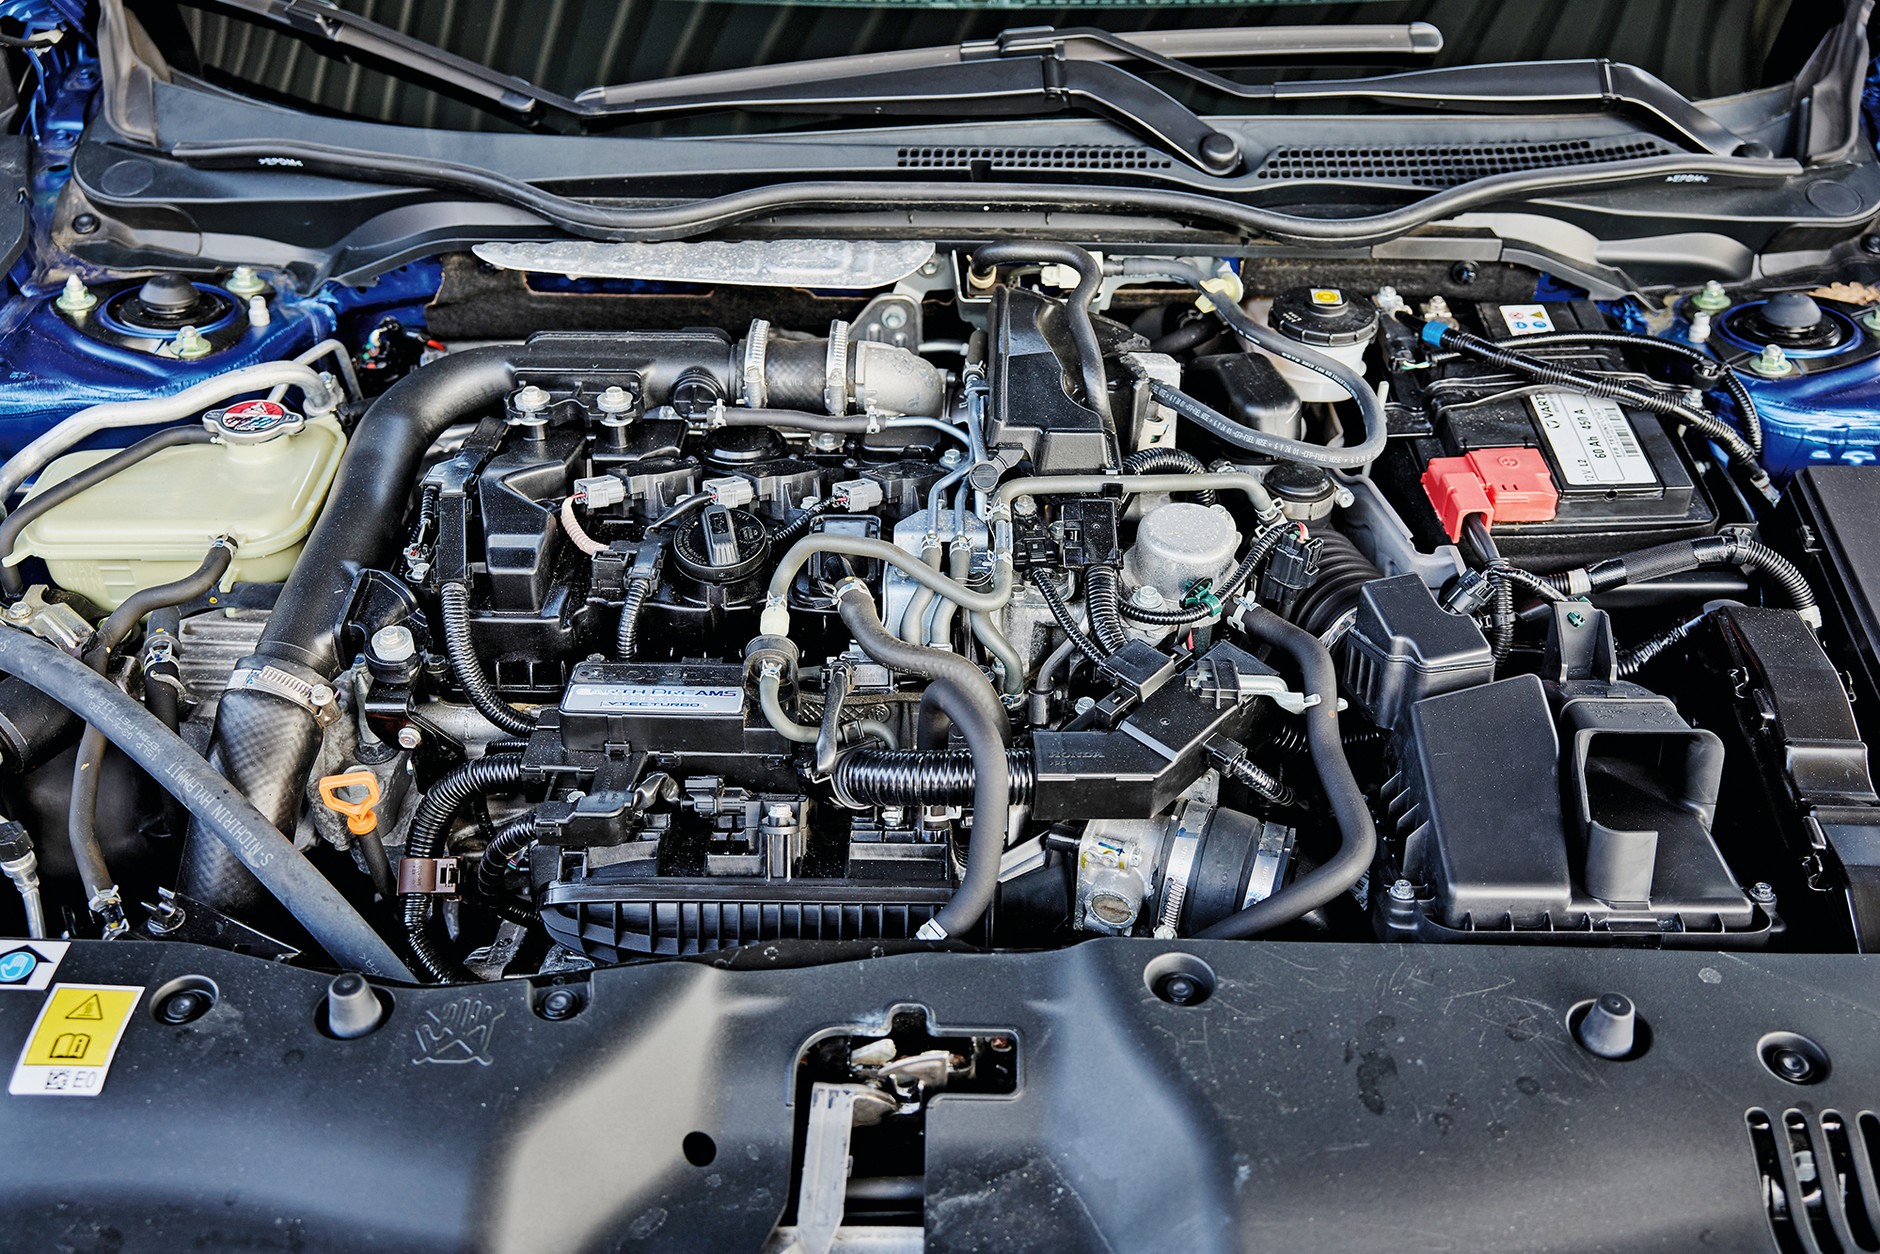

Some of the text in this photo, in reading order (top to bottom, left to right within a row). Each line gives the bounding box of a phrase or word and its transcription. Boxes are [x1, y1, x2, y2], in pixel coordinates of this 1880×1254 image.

[1536, 391, 1556, 418] VART
[1587, 436, 1602, 447] Ah
[1592, 448, 1608, 458] 60
